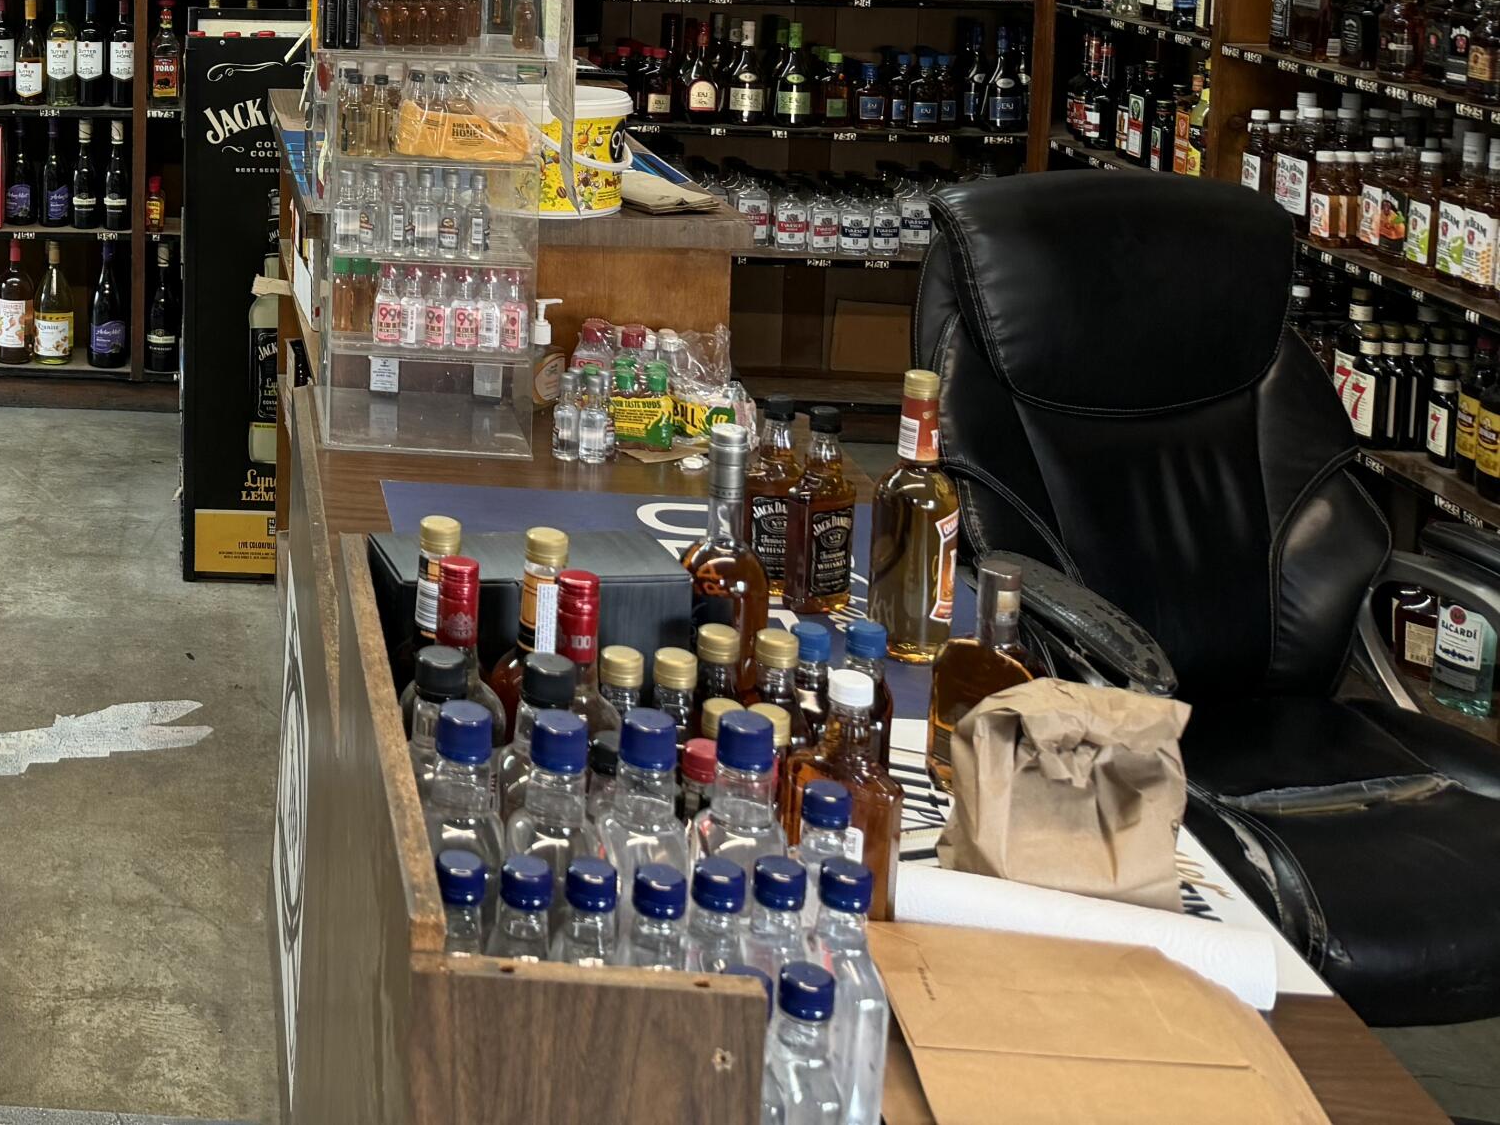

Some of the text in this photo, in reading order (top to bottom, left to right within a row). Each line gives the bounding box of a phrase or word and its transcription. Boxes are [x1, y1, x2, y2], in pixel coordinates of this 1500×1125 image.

[203, 98, 268, 145] JACK
[1336, 365, 1352, 397] 7
[624, 400, 660, 409] TASTE BUDS
[1352, 382, 1367, 421] 7
[1431, 412, 1441, 441] 7
[813, 518, 830, 536] JACK
[817, 559, 847, 570] WHISKEY
